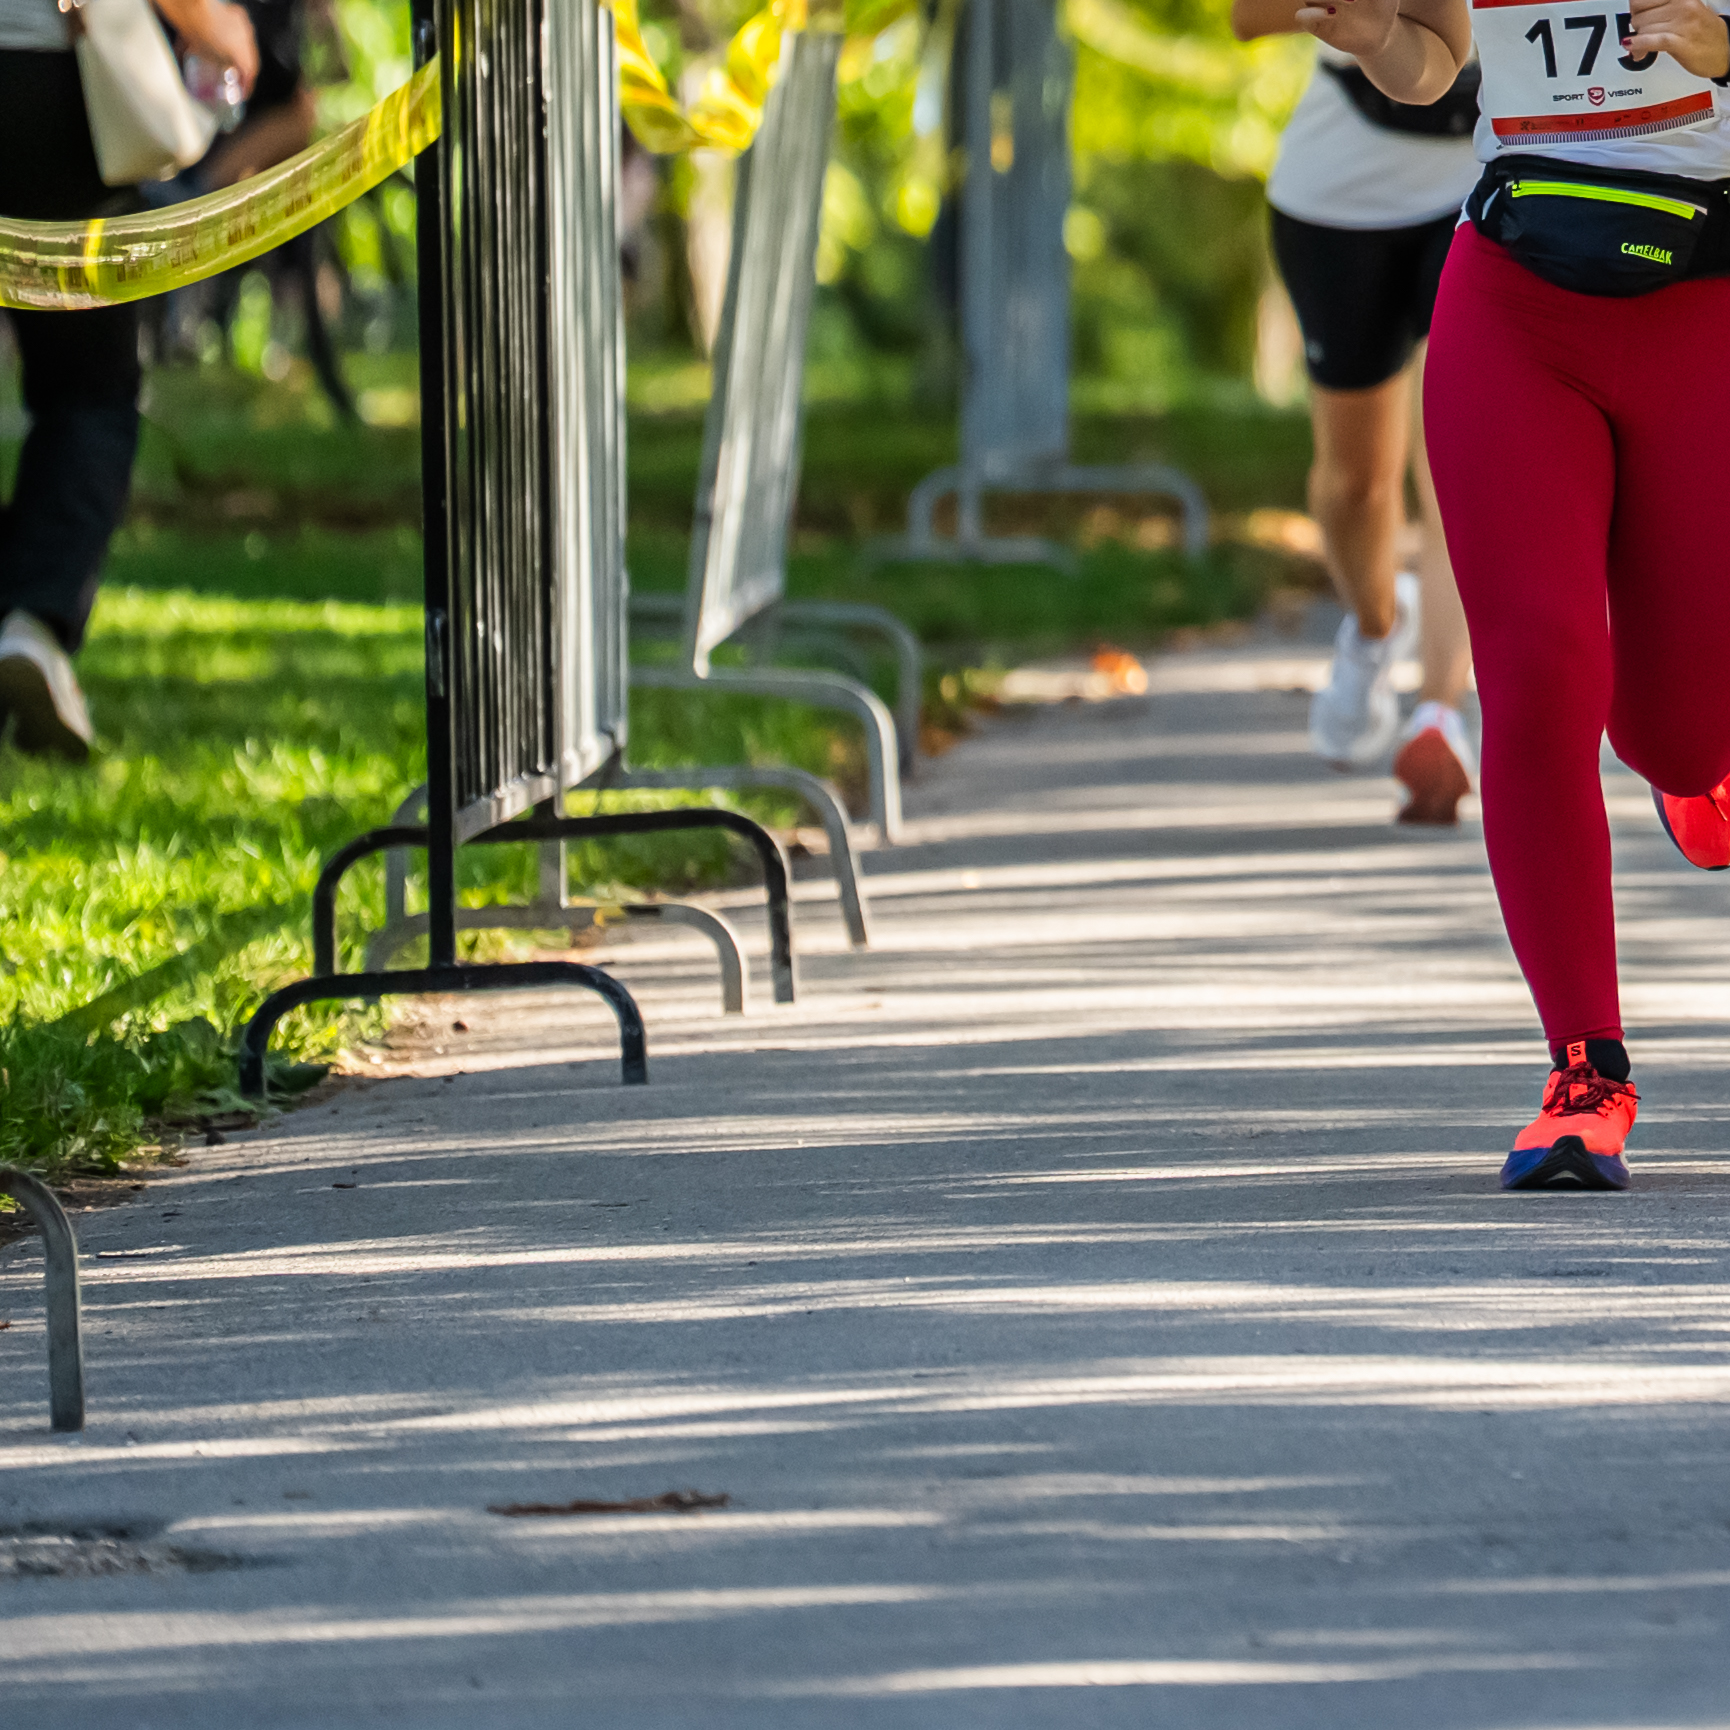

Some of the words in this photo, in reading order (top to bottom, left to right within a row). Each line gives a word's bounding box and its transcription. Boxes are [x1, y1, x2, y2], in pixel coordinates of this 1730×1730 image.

[1524, 12, 1659, 79] 175
[1552, 93, 1585, 102] SPORT
[1607, 88, 1643, 98] VISION
[1620, 242, 1673, 266] CAMELBAK
